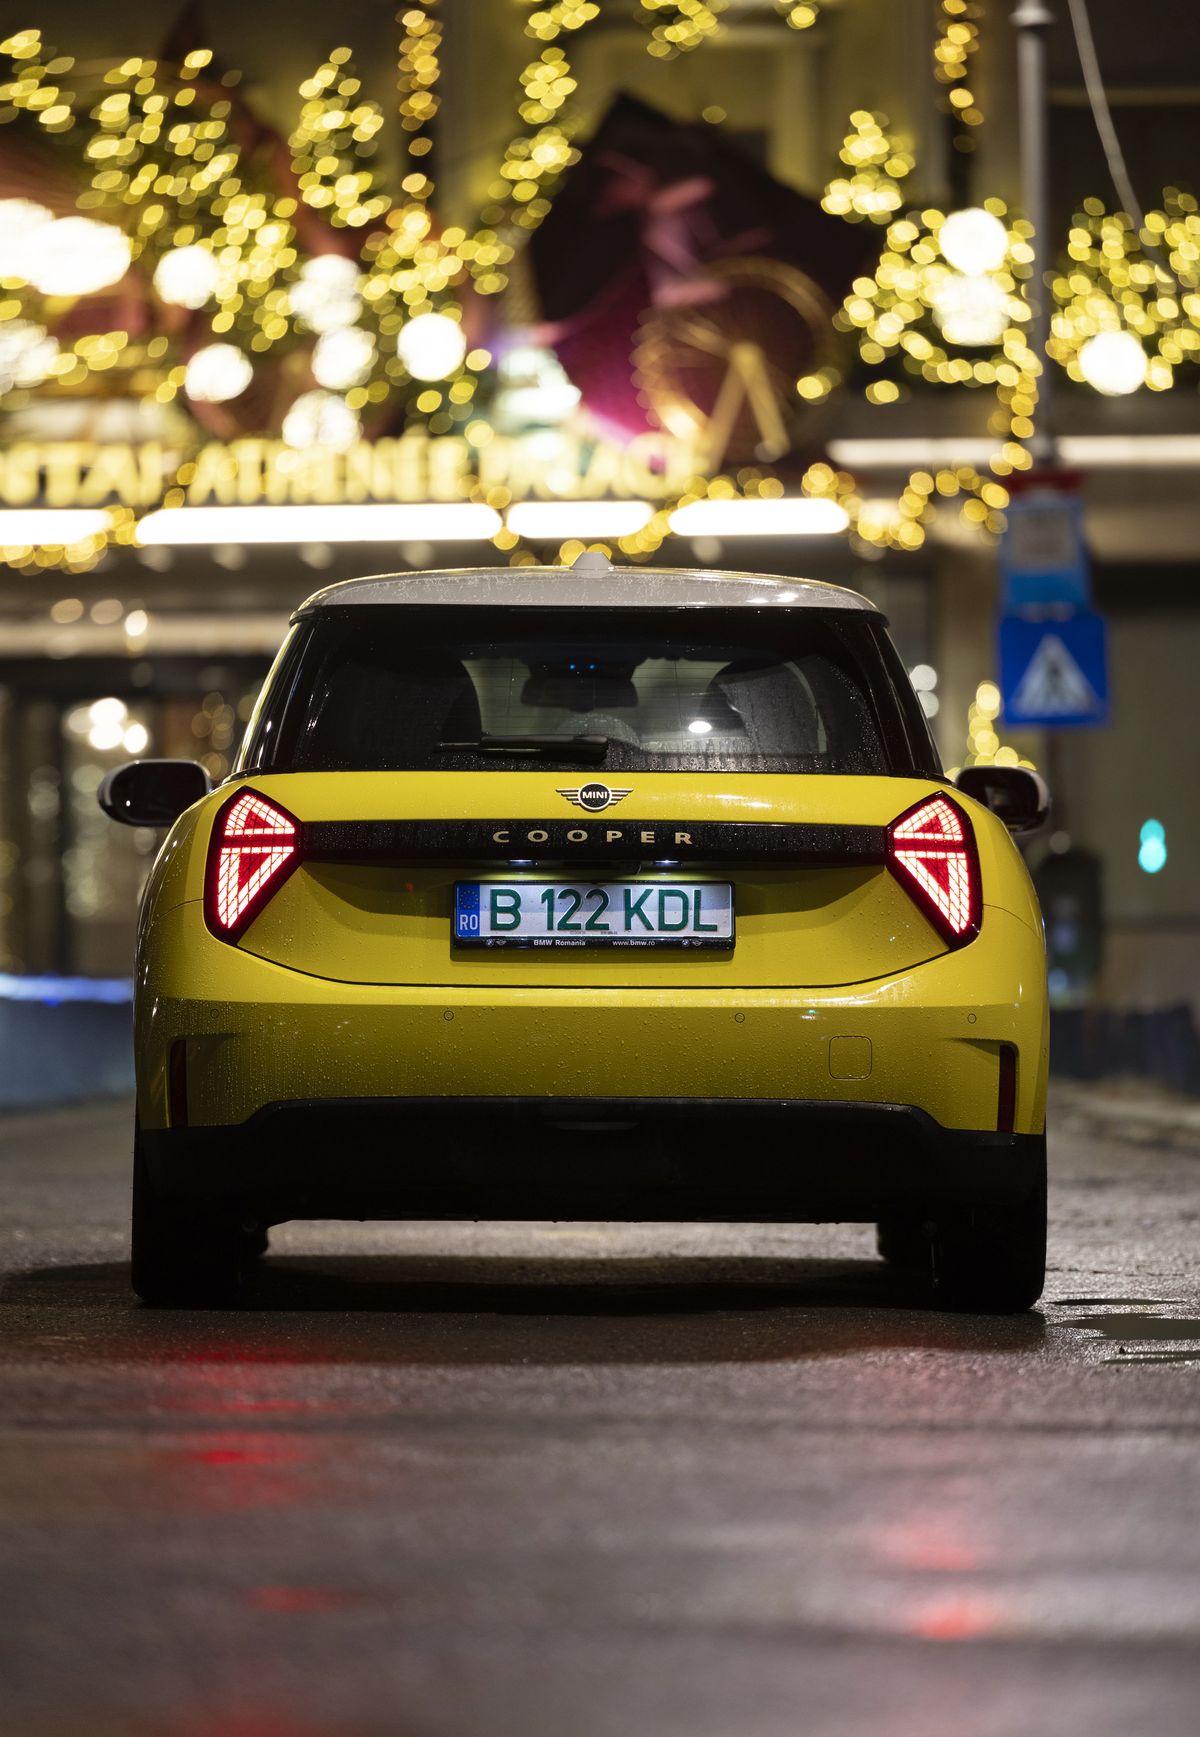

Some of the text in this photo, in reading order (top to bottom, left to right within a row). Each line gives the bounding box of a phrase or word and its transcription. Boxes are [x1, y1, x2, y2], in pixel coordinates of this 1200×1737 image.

[582, 791, 608, 799] MINI
[492, 830, 693, 845] COOPER
[490, 888, 718, 932] B 122 KDL
[459, 914, 478, 930] RO
